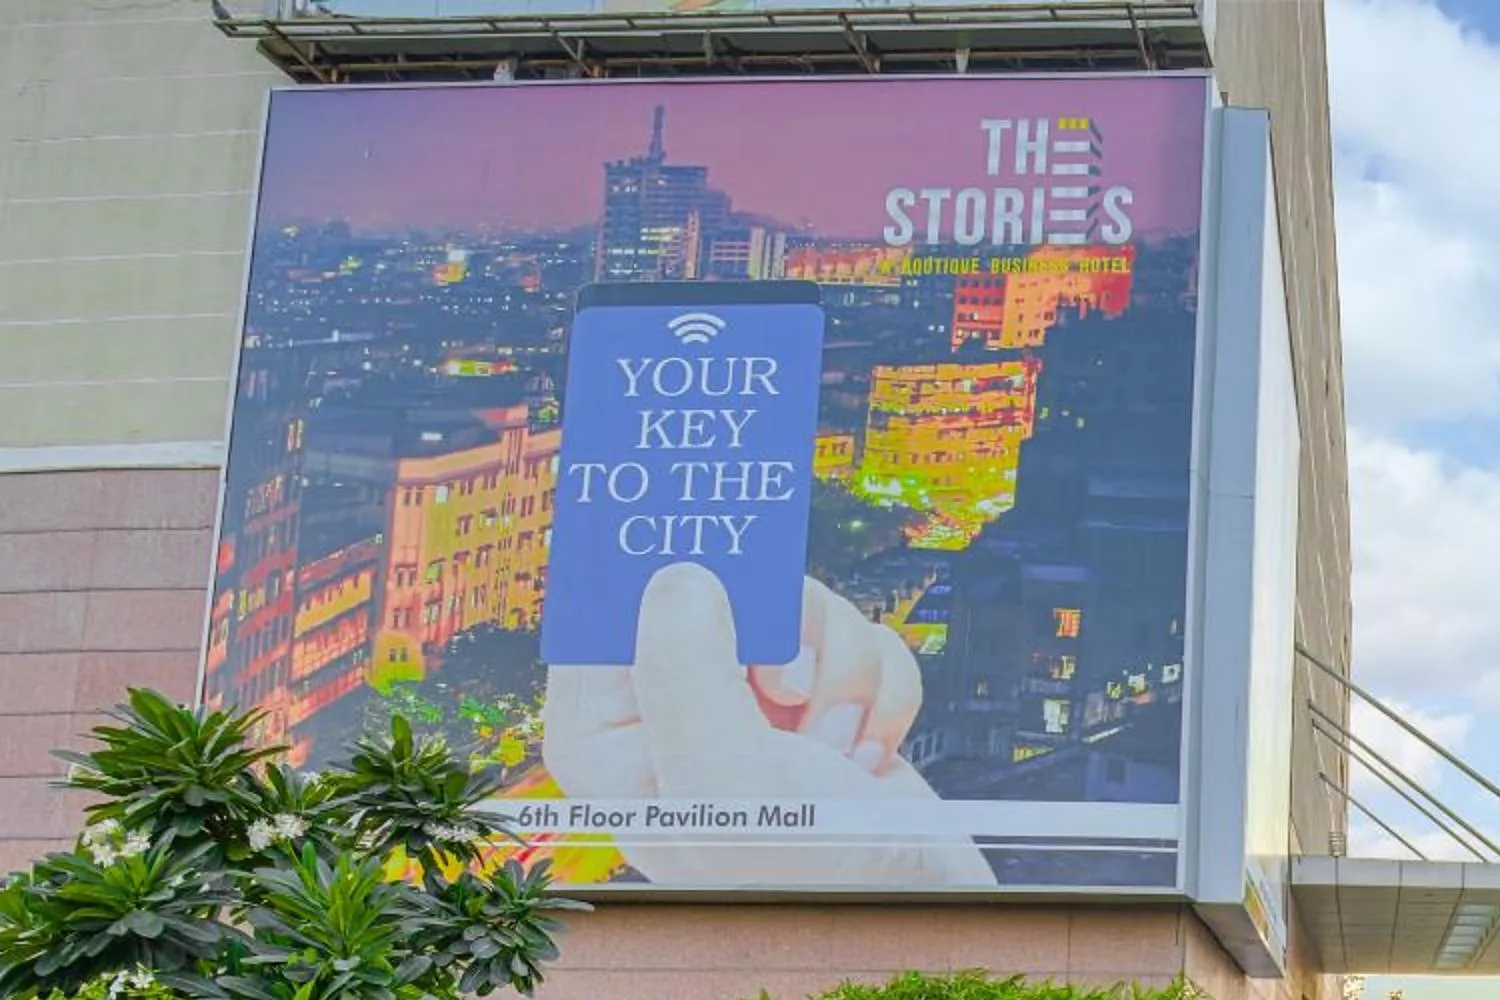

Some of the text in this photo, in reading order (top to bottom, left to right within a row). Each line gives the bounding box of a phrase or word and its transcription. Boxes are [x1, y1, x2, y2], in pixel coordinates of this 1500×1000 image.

[980, 117, 1092, 175] THE
[884, 186, 1133, 245] STORIES
[1078, 256, 1131, 274] HOTEL
[616, 356, 780, 398] YOUR
[635, 408, 759, 449] KEY
[568, 461, 795, 503] TO THE
[618, 514, 759, 555] CITY
[518, 804, 816, 828] 6th Floor Pavilion Mall
